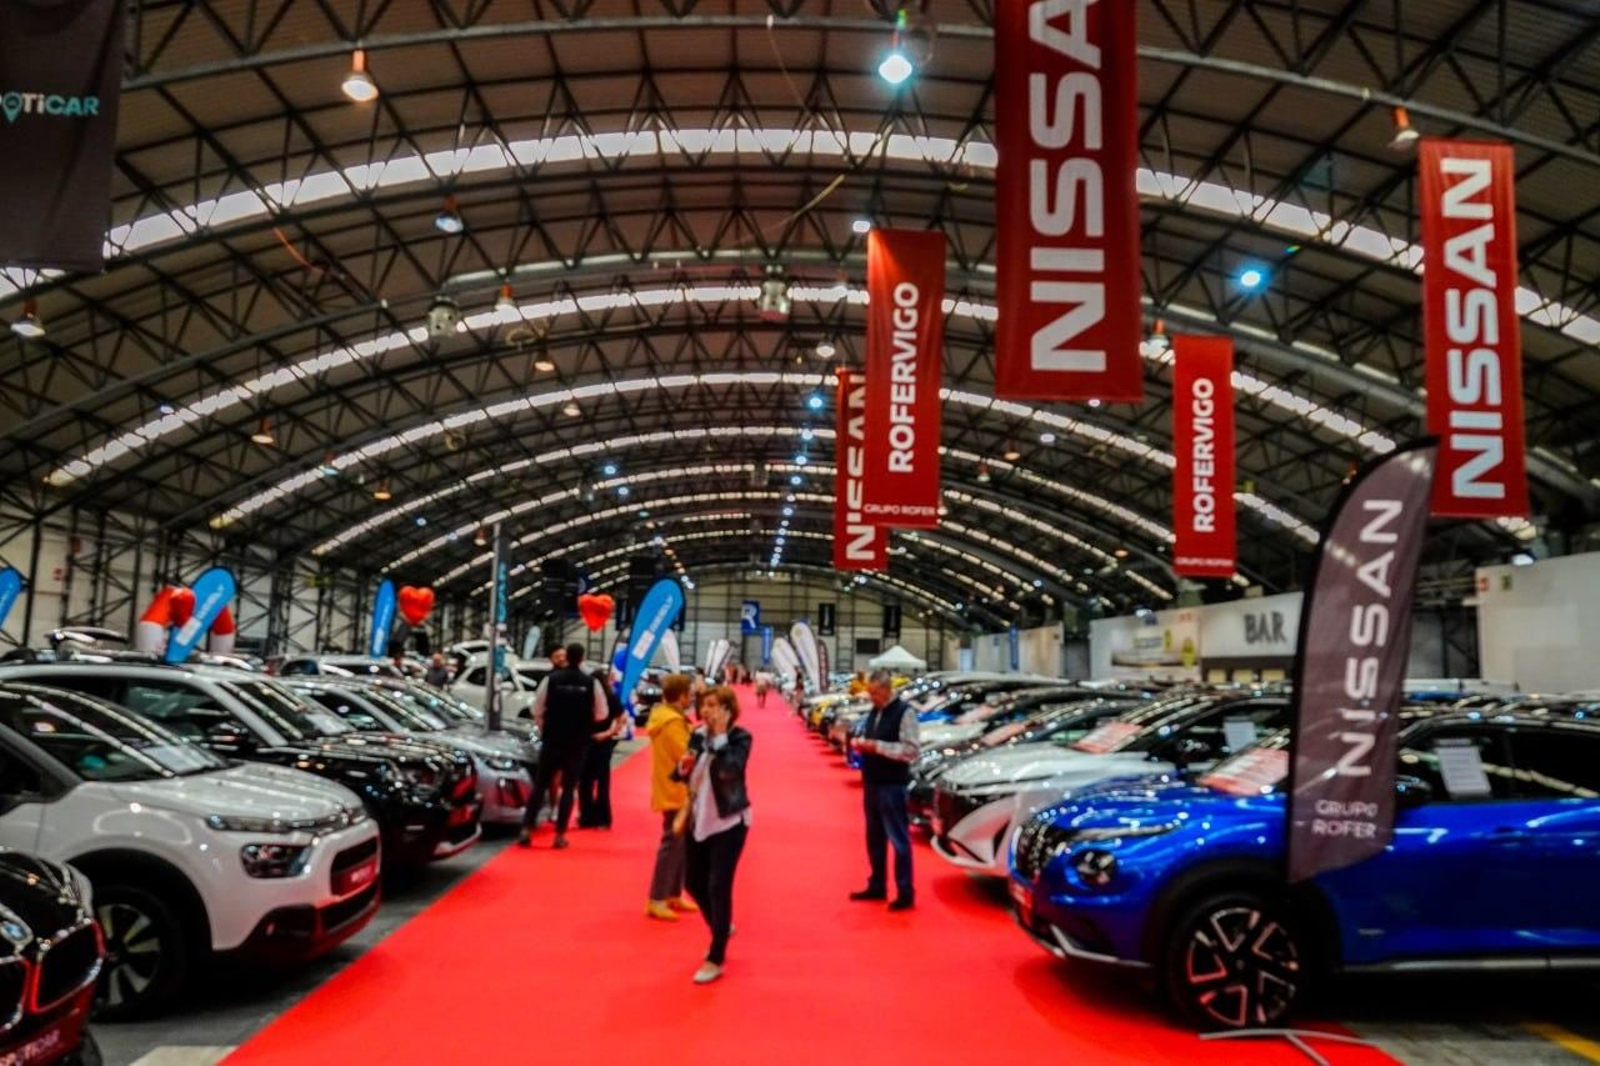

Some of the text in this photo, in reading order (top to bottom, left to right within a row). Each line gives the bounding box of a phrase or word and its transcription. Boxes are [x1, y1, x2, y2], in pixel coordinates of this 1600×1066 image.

[1440, 157, 1505, 499] NISSAN
[888, 281, 919, 473] ROFERVIGO
[1192, 377, 1215, 533] ROFERVIGO
[863, 503, 936, 516] GRUPO ROFER
[1244, 612, 1286, 644] BAR
[1336, 499, 1403, 777] NISSAN
[1312, 818, 1377, 838] ROFER
[1315, 799, 1379, 818] GRUPO
